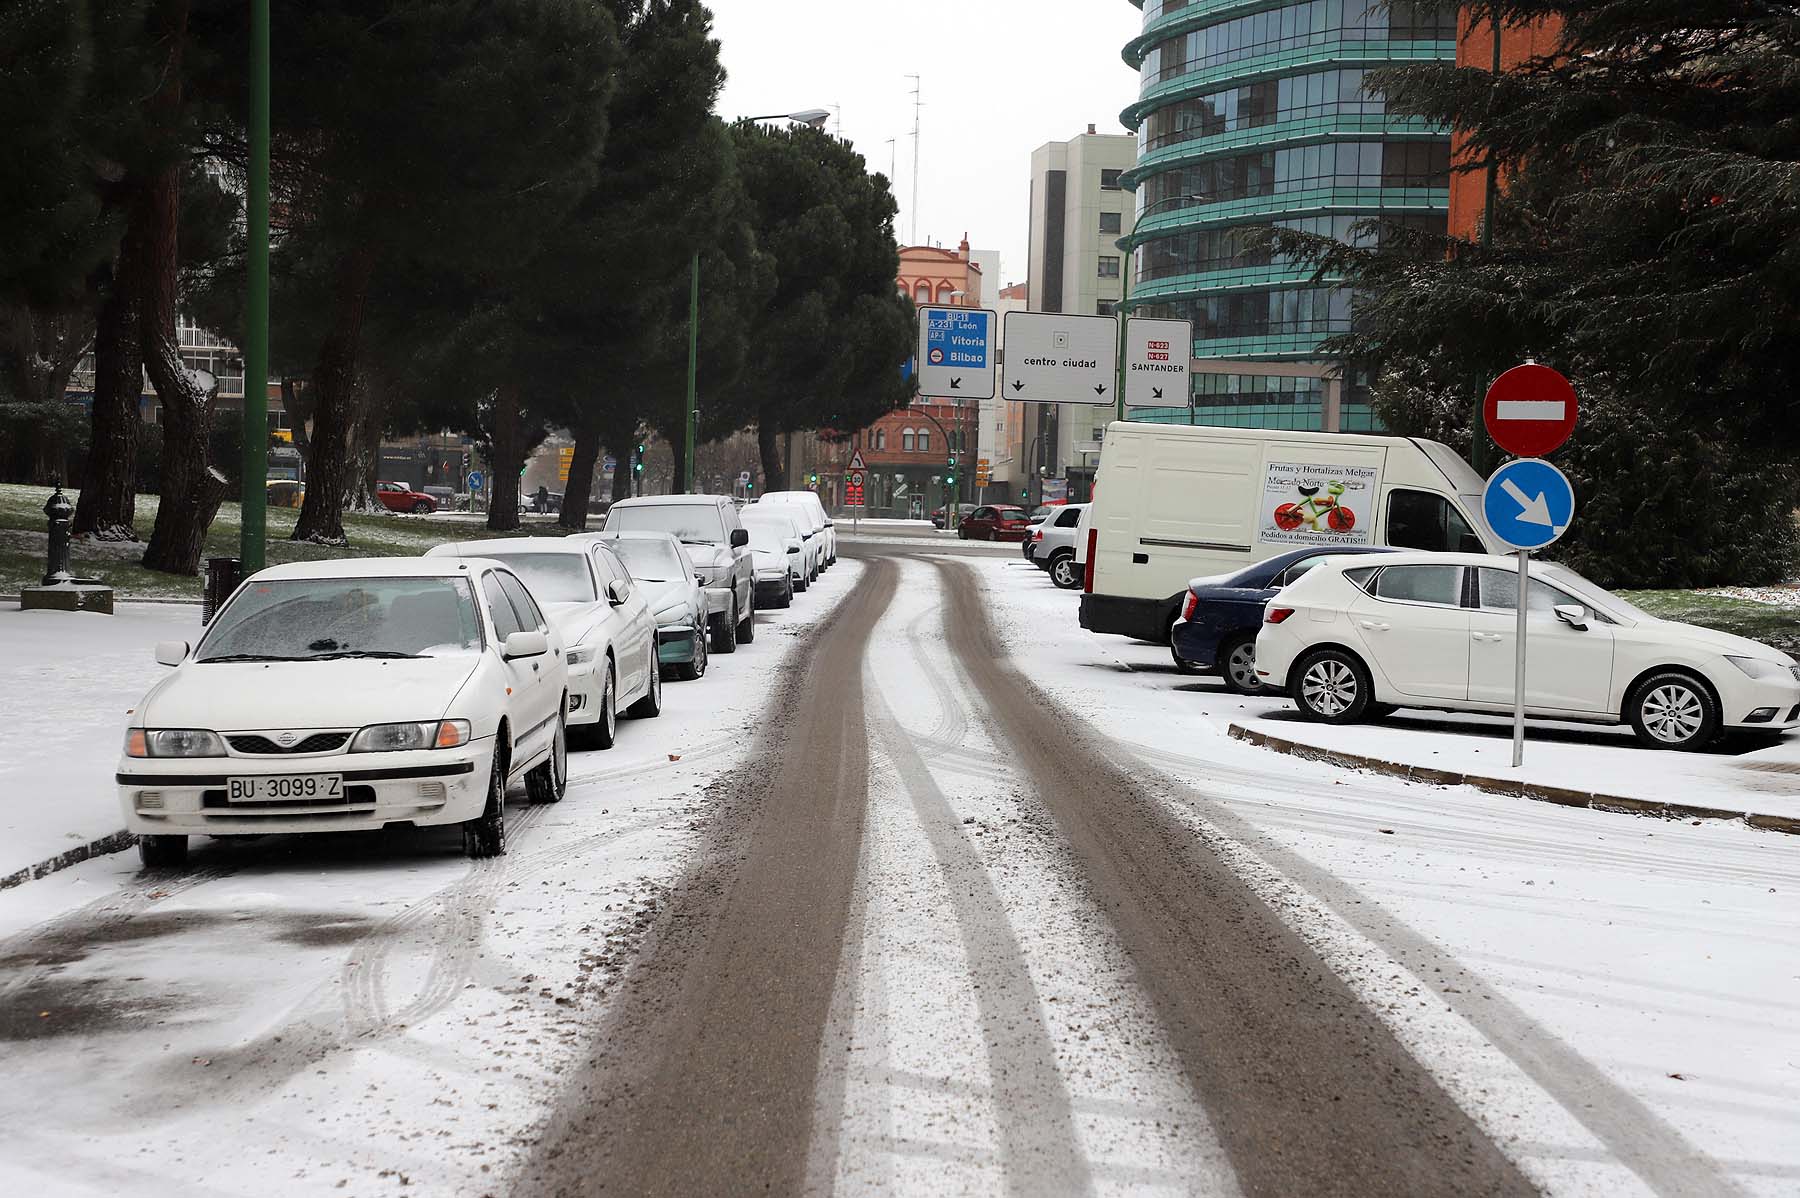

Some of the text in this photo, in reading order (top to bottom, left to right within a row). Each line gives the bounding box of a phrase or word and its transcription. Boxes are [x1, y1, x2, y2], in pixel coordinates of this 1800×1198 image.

[929, 320, 977, 329] A-231 León
[951, 336, 985, 346] Vitoria
[951, 352, 983, 362] Bilbao
[1024, 357, 1096, 368] centro ciudad
[1131, 363, 1184, 372] SANTANDER
[1269, 464, 1294, 472] Frutas
[1303, 466, 1343, 475] Hortalizas
[1345, 468, 1375, 478] Melgar
[1261, 531, 1287, 539] Pedidos
[1294, 533, 1327, 542] domicilio
[1328, 535, 1366, 545] GRATIS!!!
